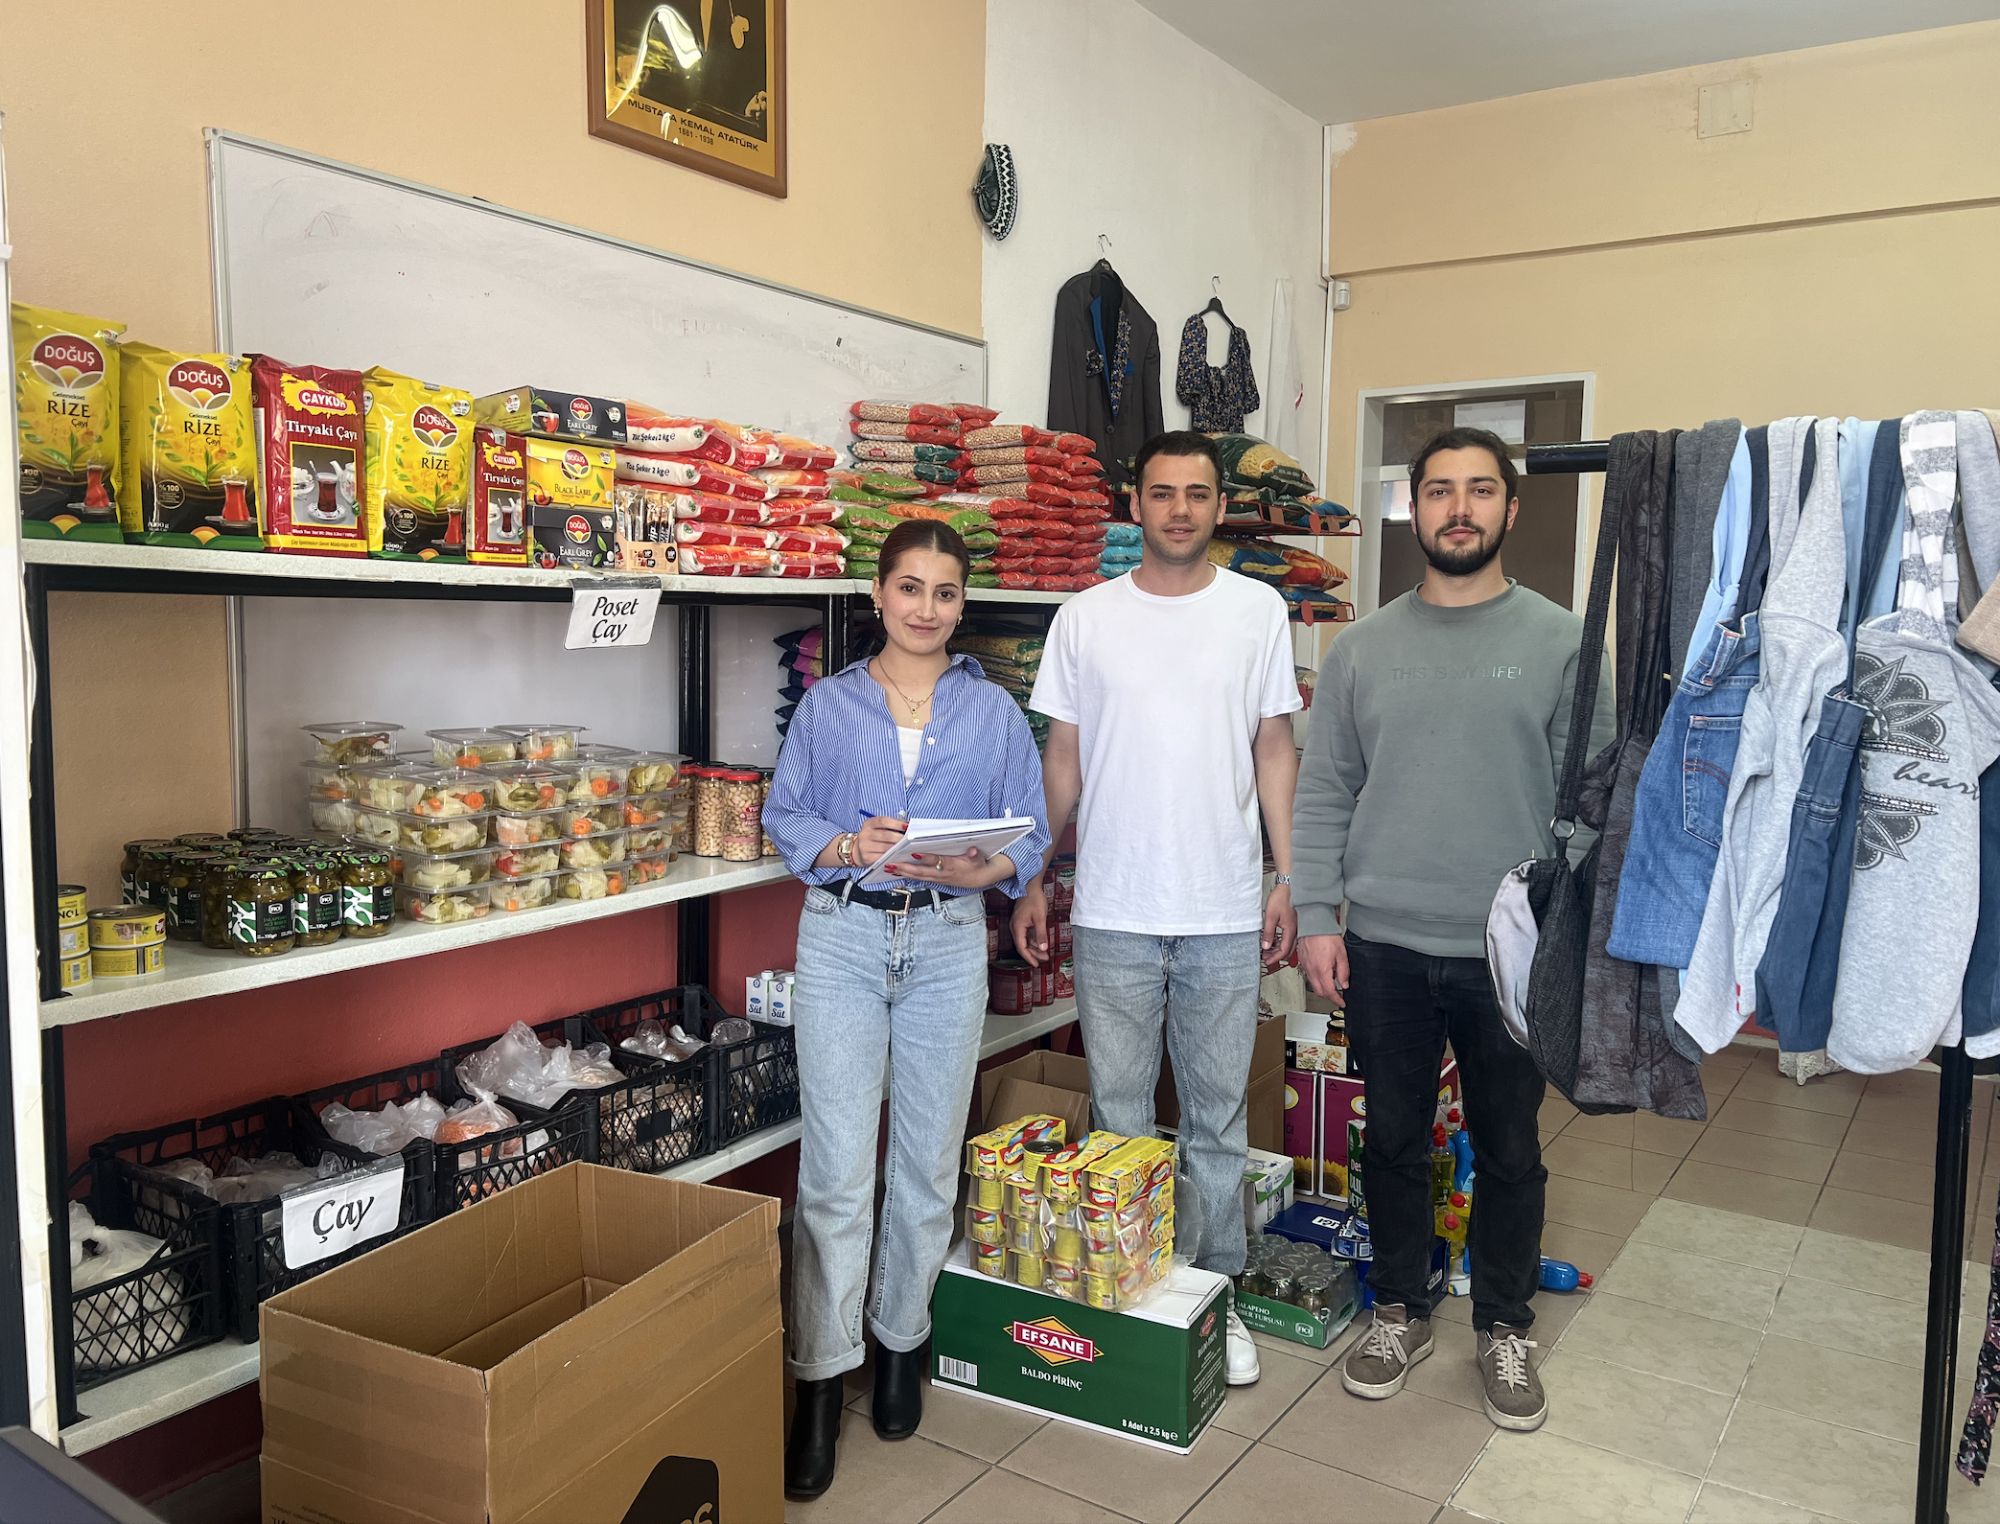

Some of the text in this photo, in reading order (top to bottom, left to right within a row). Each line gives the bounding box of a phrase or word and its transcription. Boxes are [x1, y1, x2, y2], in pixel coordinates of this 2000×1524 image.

[628, 99, 760, 152] MUSTAA KEMAL ATATÜRK
[679, 127, 694, 139] 1881
[700, 134, 715, 146] 1938
[44, 345, 95, 367] DOĞUŞ
[177, 370, 224, 389] DOĞUŞ
[47, 400, 91, 418] RİZE
[184, 419, 222, 437] RİZE
[285, 420, 358, 442] Tiryaki Çayı
[421, 456, 450, 471] RİZE
[554, 483, 573, 494] BLACK
[574, 486, 592, 497] LABEL
[560, 545, 593, 557] EARL GREY
[591, 619, 628, 643] Çay
[748, 1004, 763, 1014] Süt
[771, 1008, 786, 1019] Süt
[313, 1196, 375, 1244] Çay
[1237, 1301, 1270, 1316] JALAPENO
[1022, 1328, 1085, 1355] EFSANE
[1021, 1366, 1083, 1391] BALDO PİRİNÇ
[1122, 1418, 1127, 1427] 8
[1128, 1420, 1143, 1431] Adet
[1149, 1426, 1161, 1436] 2,5
